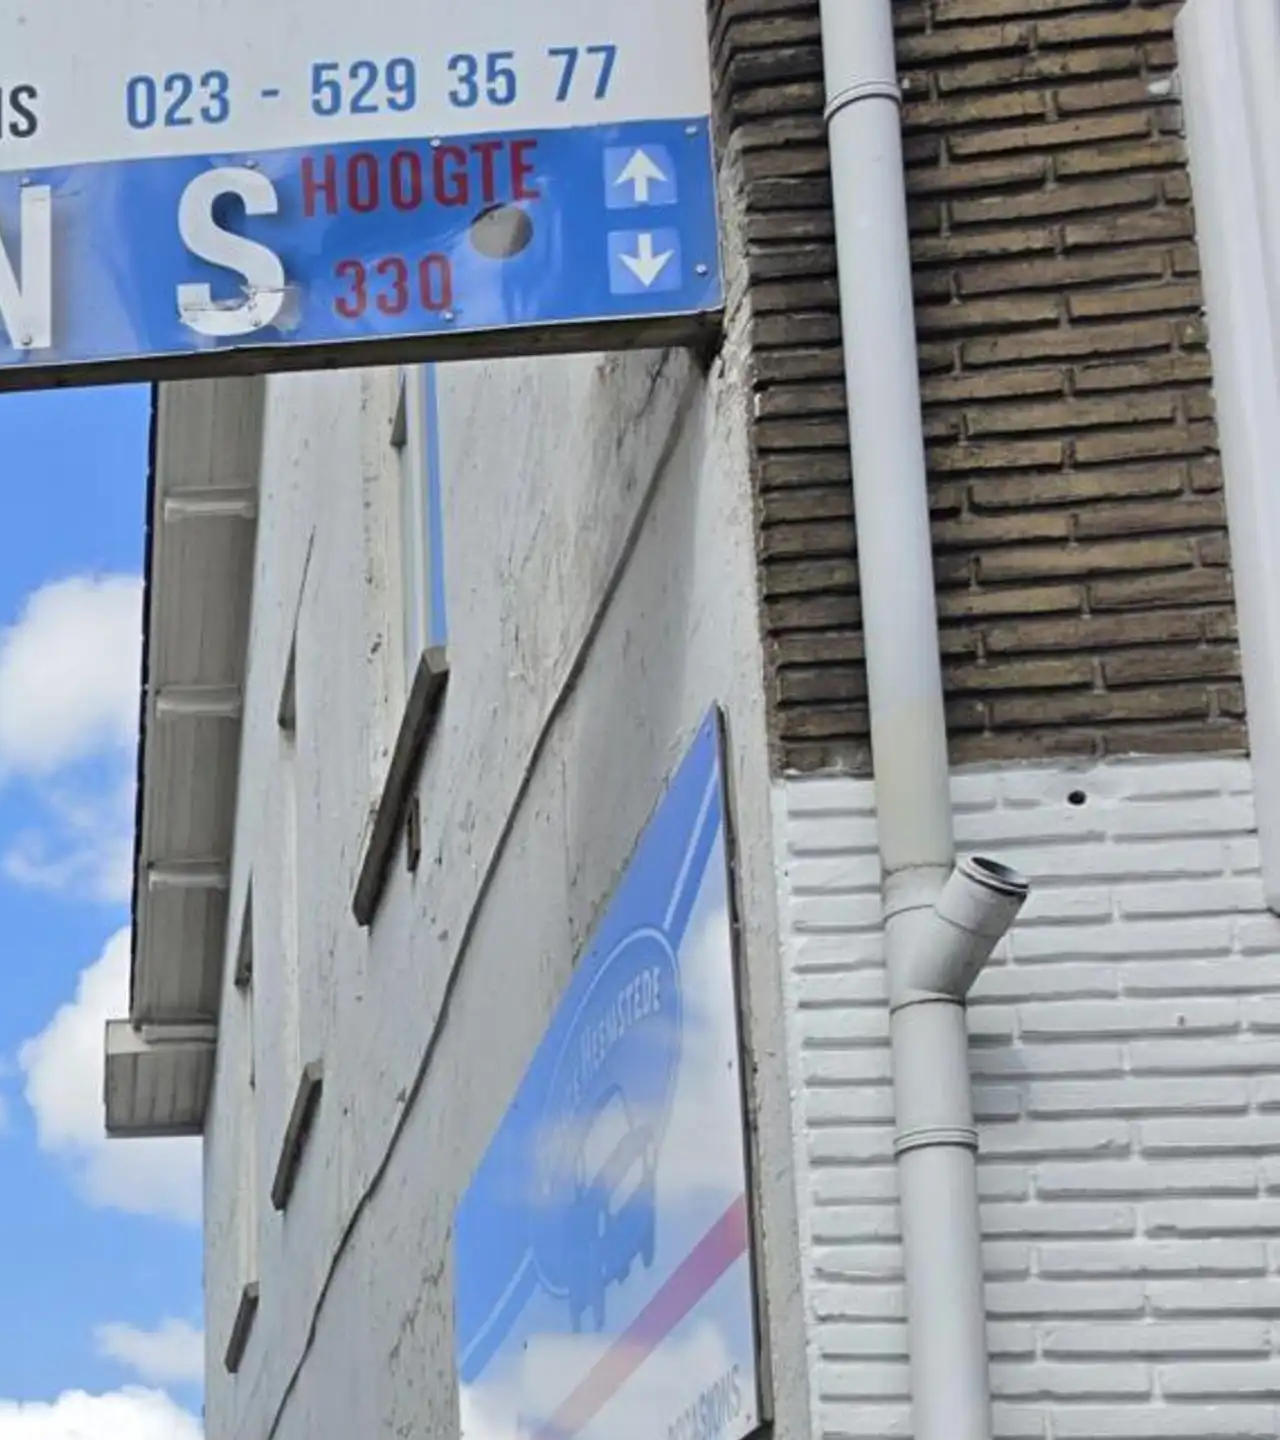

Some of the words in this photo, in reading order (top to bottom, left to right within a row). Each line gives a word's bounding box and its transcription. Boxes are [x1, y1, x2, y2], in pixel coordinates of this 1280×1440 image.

[125, 70, 231, 130] 023
[310, 57, 418, 116] 529
[447, 51, 518, 108] 35
[547, 44, 619, 102] 77
[300, 138, 540, 218] HOOGTE
[333, 252, 454, 319] 330
